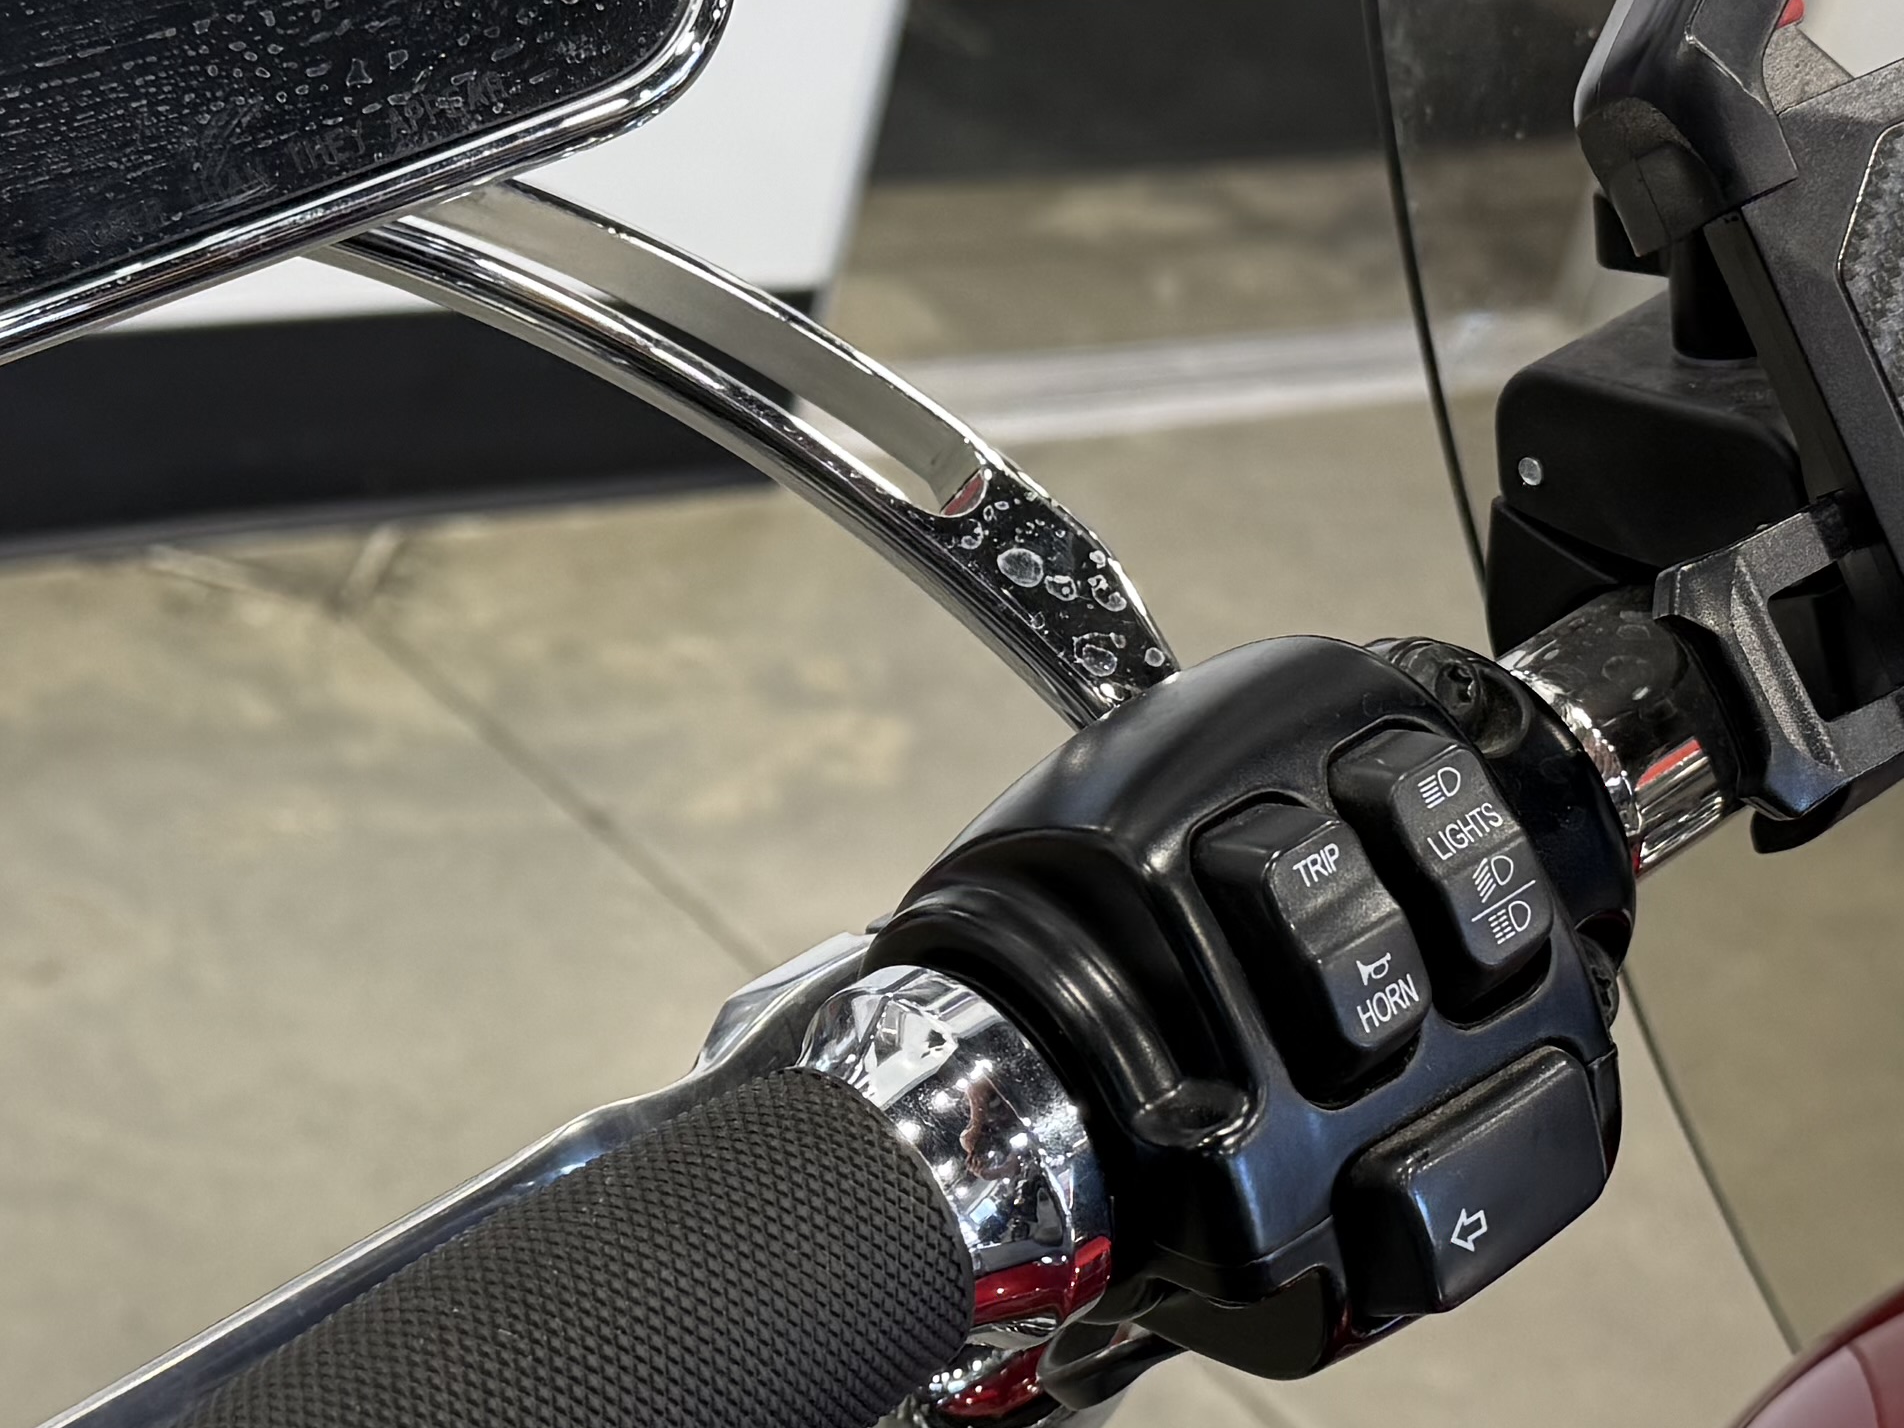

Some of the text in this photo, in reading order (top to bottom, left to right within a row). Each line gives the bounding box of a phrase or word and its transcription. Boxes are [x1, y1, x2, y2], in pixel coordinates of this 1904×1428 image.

[1427, 801, 1505, 861] LIGHTS
[1291, 840, 1341, 889] TRIP
[1355, 974, 1421, 1034] HORN
